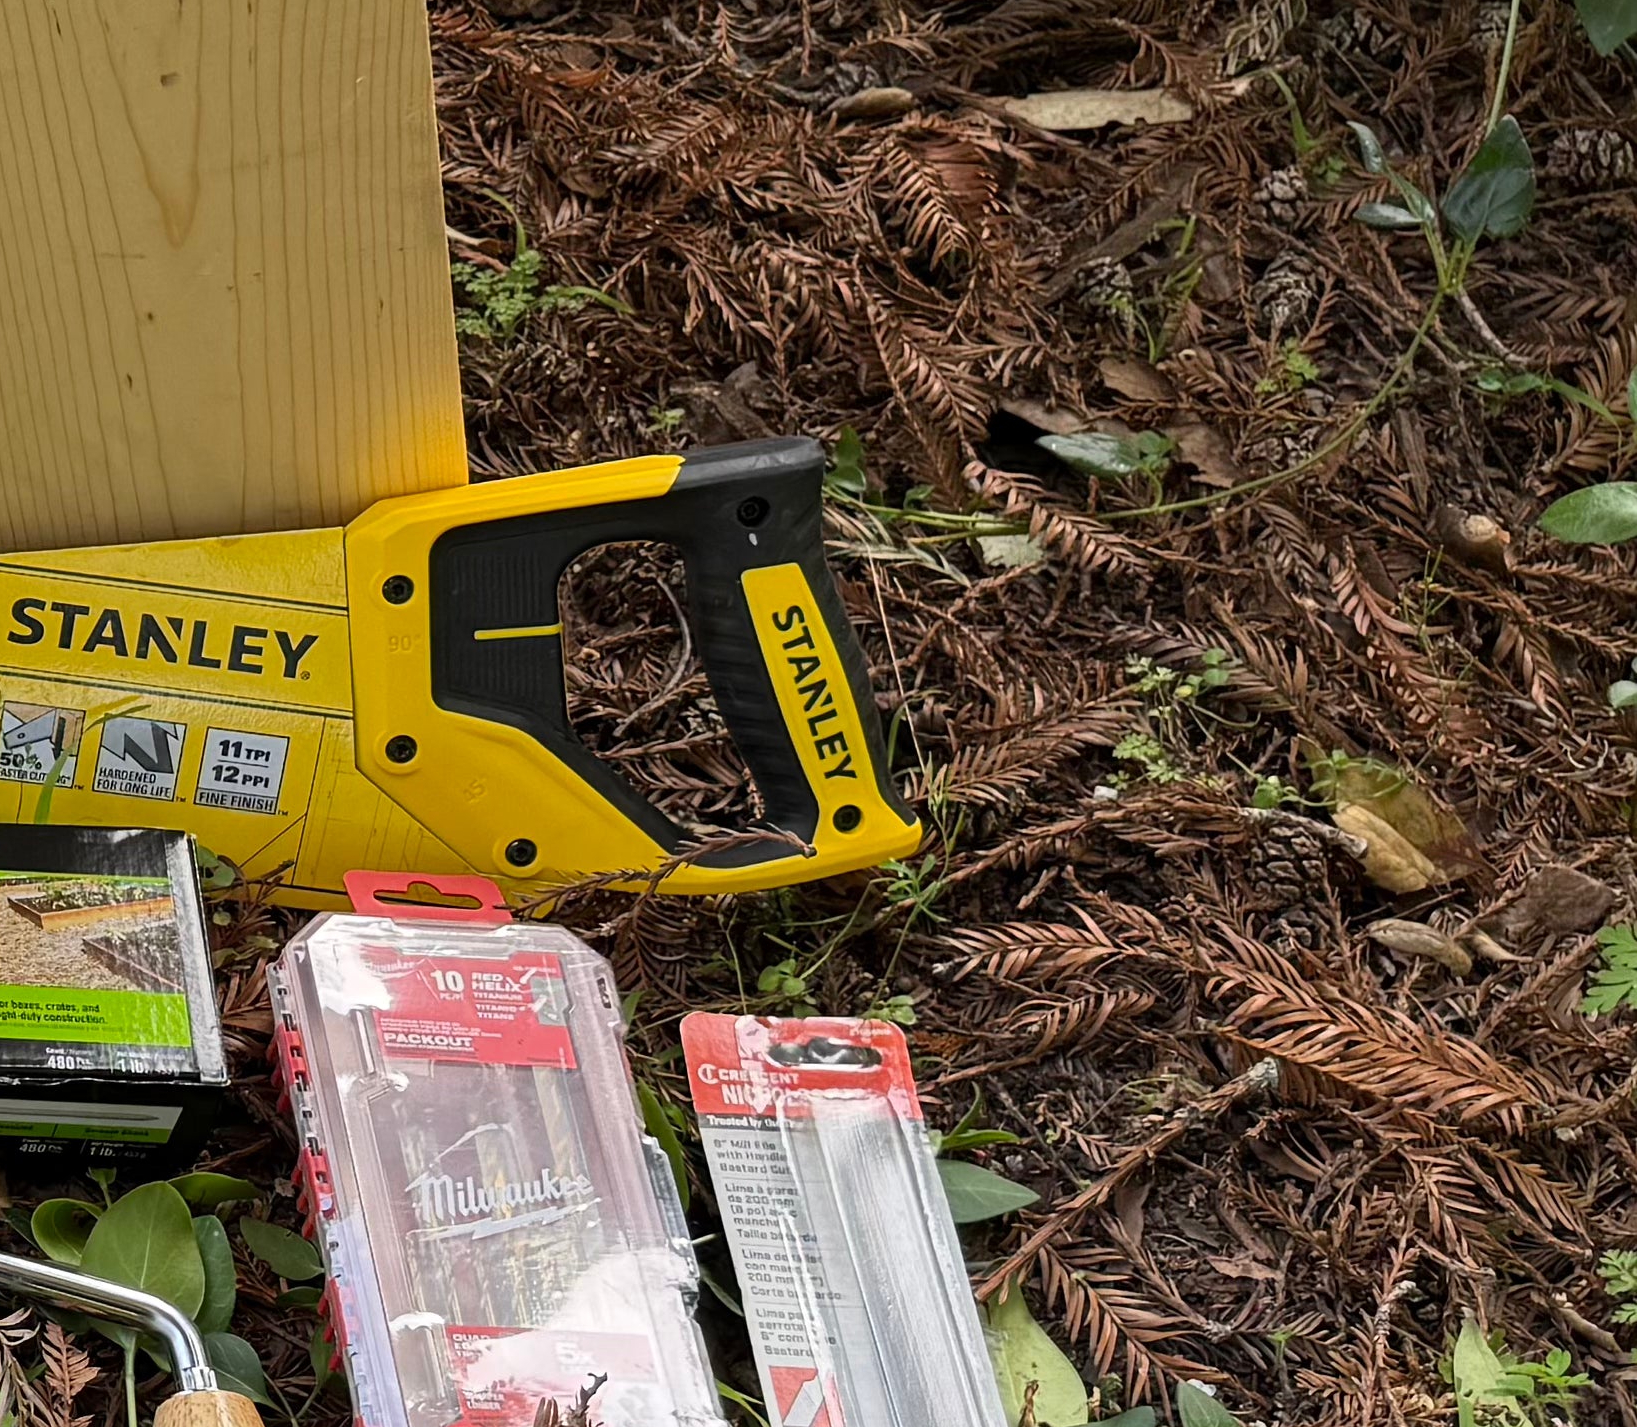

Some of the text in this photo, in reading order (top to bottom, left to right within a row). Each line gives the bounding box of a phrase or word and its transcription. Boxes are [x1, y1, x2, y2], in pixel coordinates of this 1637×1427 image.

[7, 598, 320, 679] STANLEY
[771, 604, 856, 780] STANLEY
[219, 740, 270, 762] 11 TPI
[0, 752, 41, 770] 50%
[99, 768, 156, 784] HARDENED
[212, 765, 269, 788] 12 PPI
[97, 780, 171, 797] FOR LONG LIFE
[199, 792, 273, 811] FINE FINISH
[431, 970, 465, 992] 10
[472, 972, 503, 981] RED
[472, 981, 521, 992] HELIX
[384, 1033, 473, 1047] PACKOUT
[405, 1168, 594, 1223] Milwaukee
